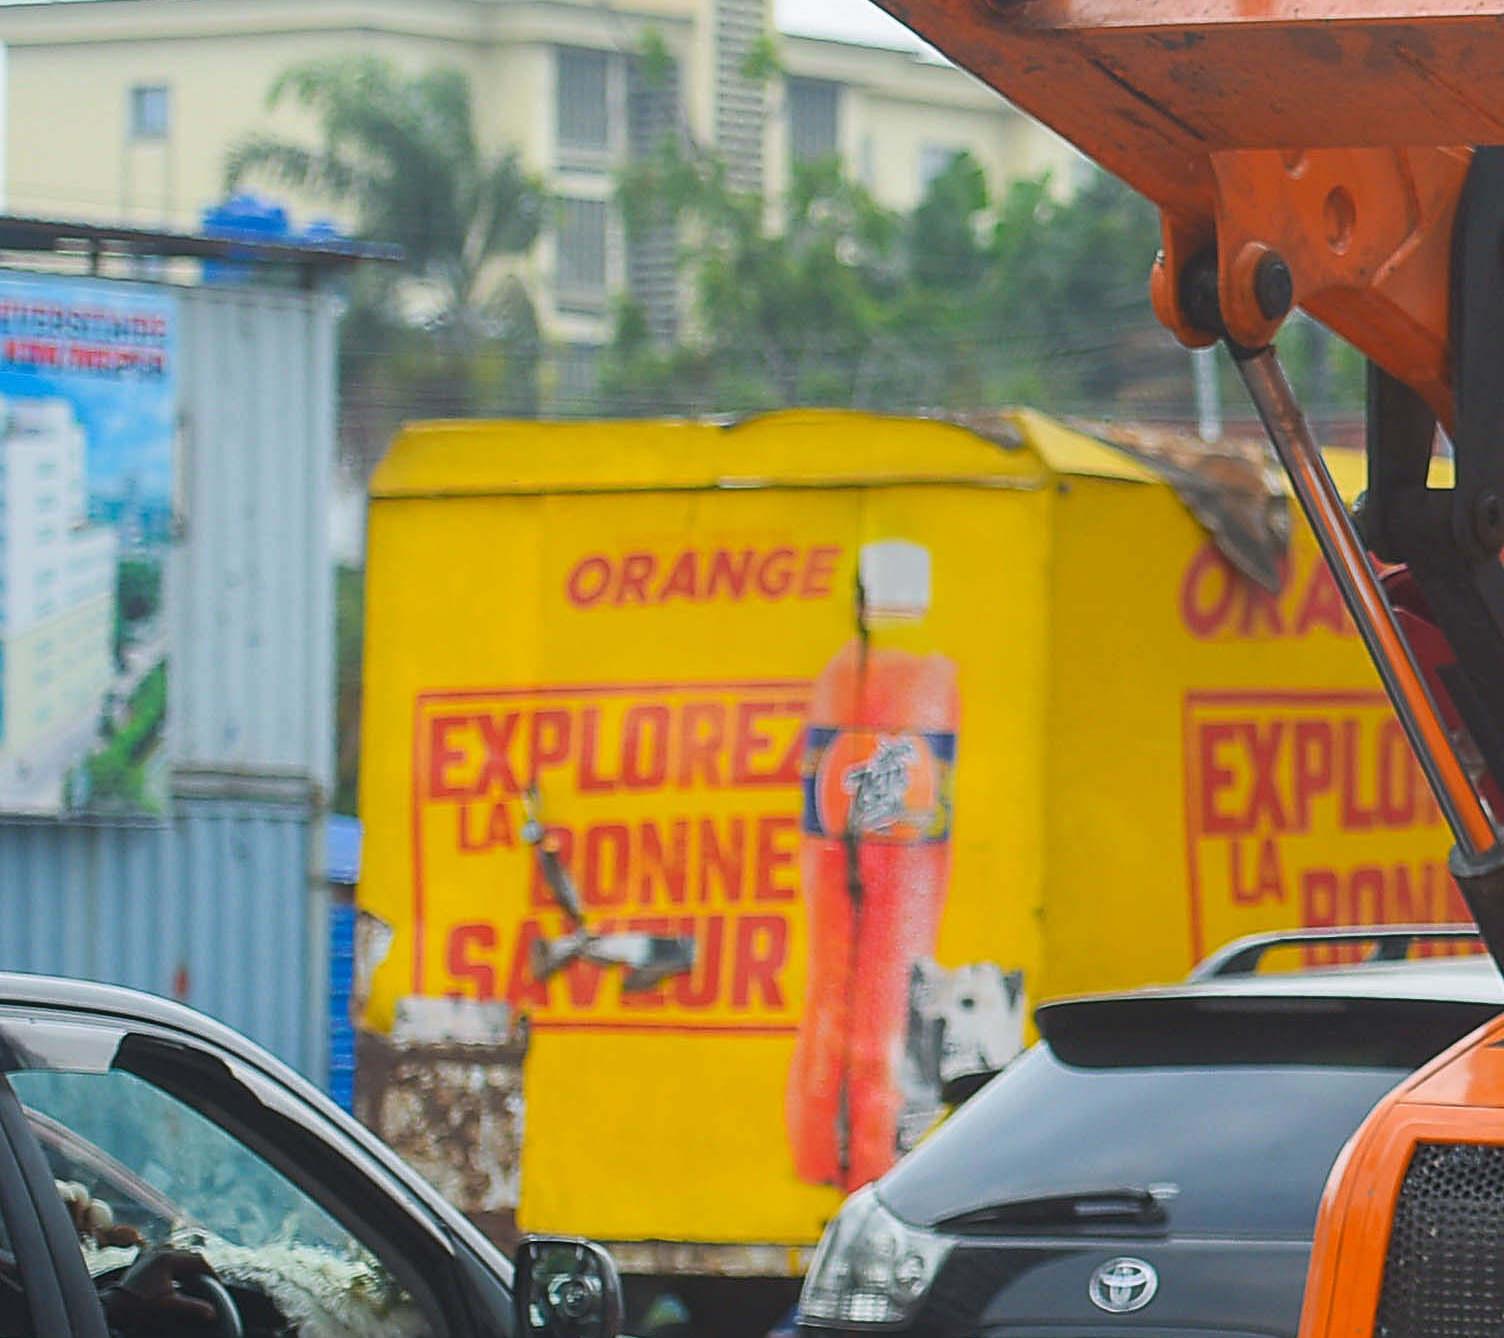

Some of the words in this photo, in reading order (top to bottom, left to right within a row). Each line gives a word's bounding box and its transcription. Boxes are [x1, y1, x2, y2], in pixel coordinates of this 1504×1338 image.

[565, 544, 843, 610] ORANGE
[457, 800, 516, 853] LA
[530, 816, 798, 909] BONNE
[1229, 835, 1285, 906] LA
